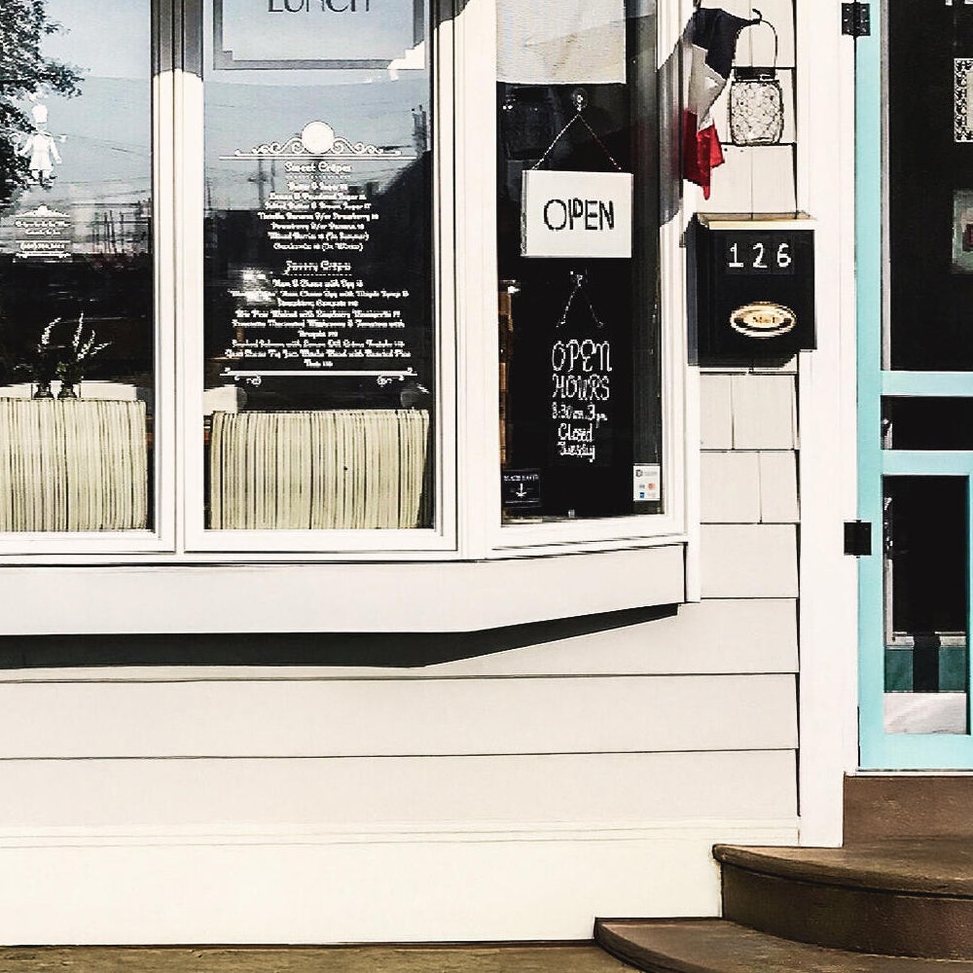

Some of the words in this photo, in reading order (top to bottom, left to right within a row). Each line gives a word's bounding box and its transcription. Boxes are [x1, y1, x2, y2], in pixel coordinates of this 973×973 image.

[544, 198, 615, 230] OPEN
[727, 242, 792, 269] 126
[551, 339, 613, 372] OPEN
[551, 373, 610, 401] HOURS
